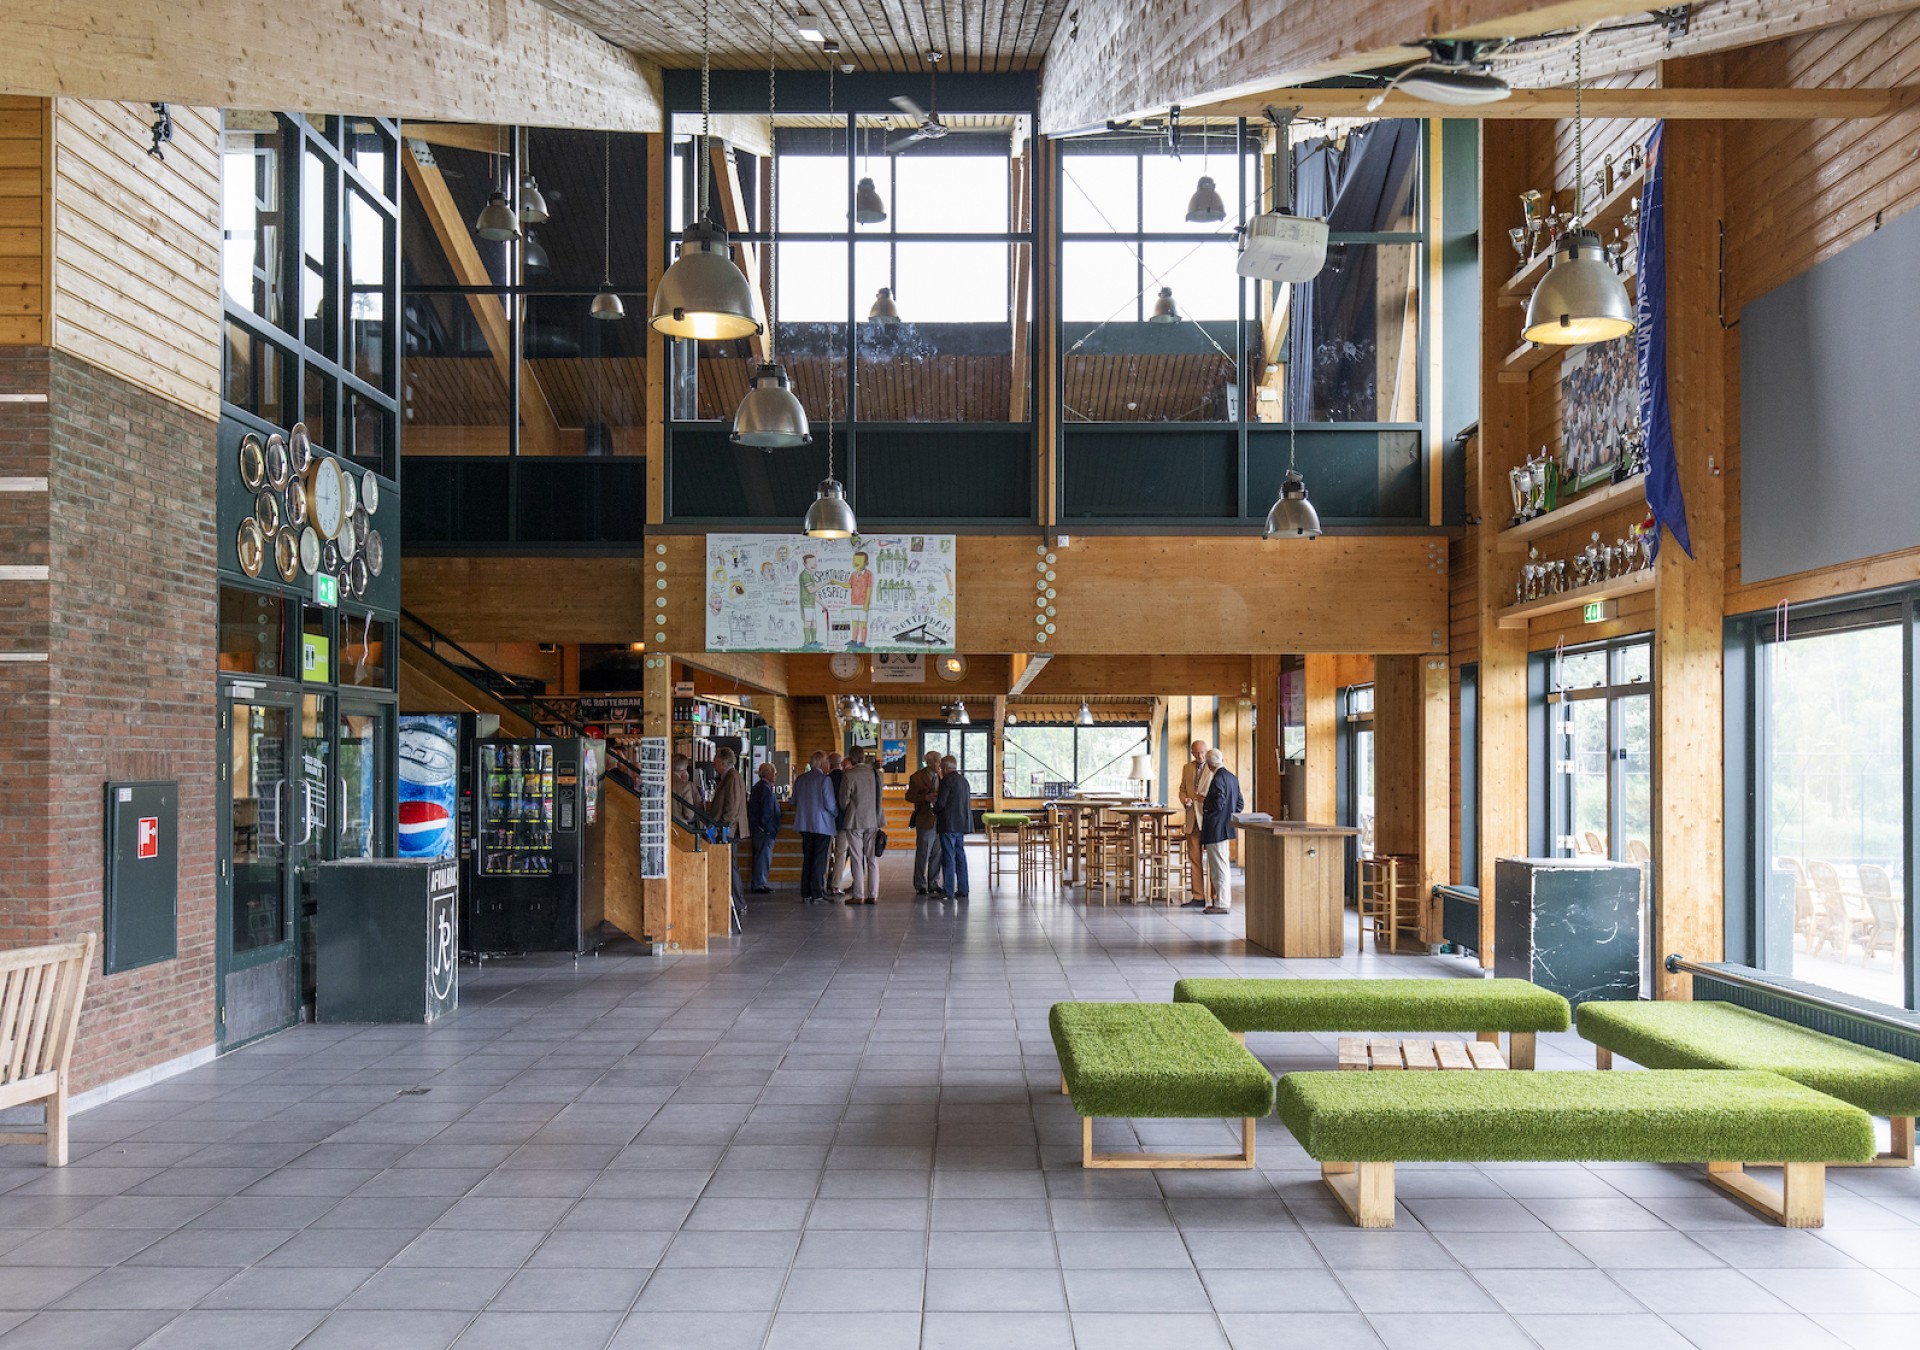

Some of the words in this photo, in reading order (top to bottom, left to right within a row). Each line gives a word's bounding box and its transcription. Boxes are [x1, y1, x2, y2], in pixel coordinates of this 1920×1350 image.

[817, 586, 849, 600] RESPECT
[893, 615, 951, 633] ROTTERDAM
[593, 698, 641, 707] ROTTERDAM
